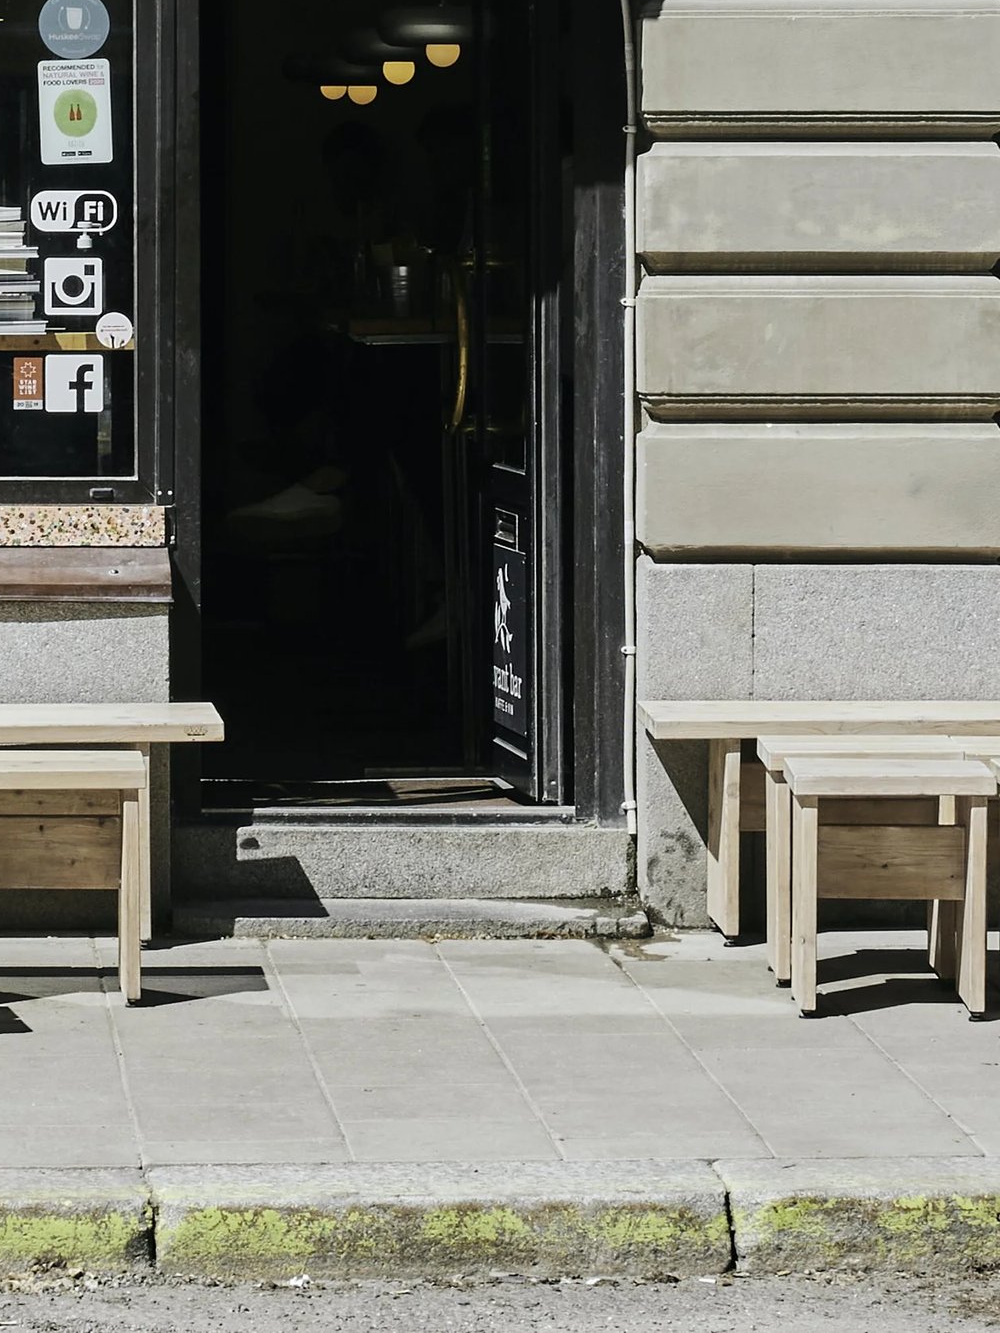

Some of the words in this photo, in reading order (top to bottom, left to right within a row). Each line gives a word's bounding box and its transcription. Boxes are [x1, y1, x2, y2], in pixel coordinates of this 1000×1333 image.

[43, 64, 96, 72] RECOMMENDED
[43, 71, 78, 79] NATURAL
[43, 79, 61, 87] FOOD
[62, 78, 87, 86] LOVERS
[510, 662, 522, 699] bar
